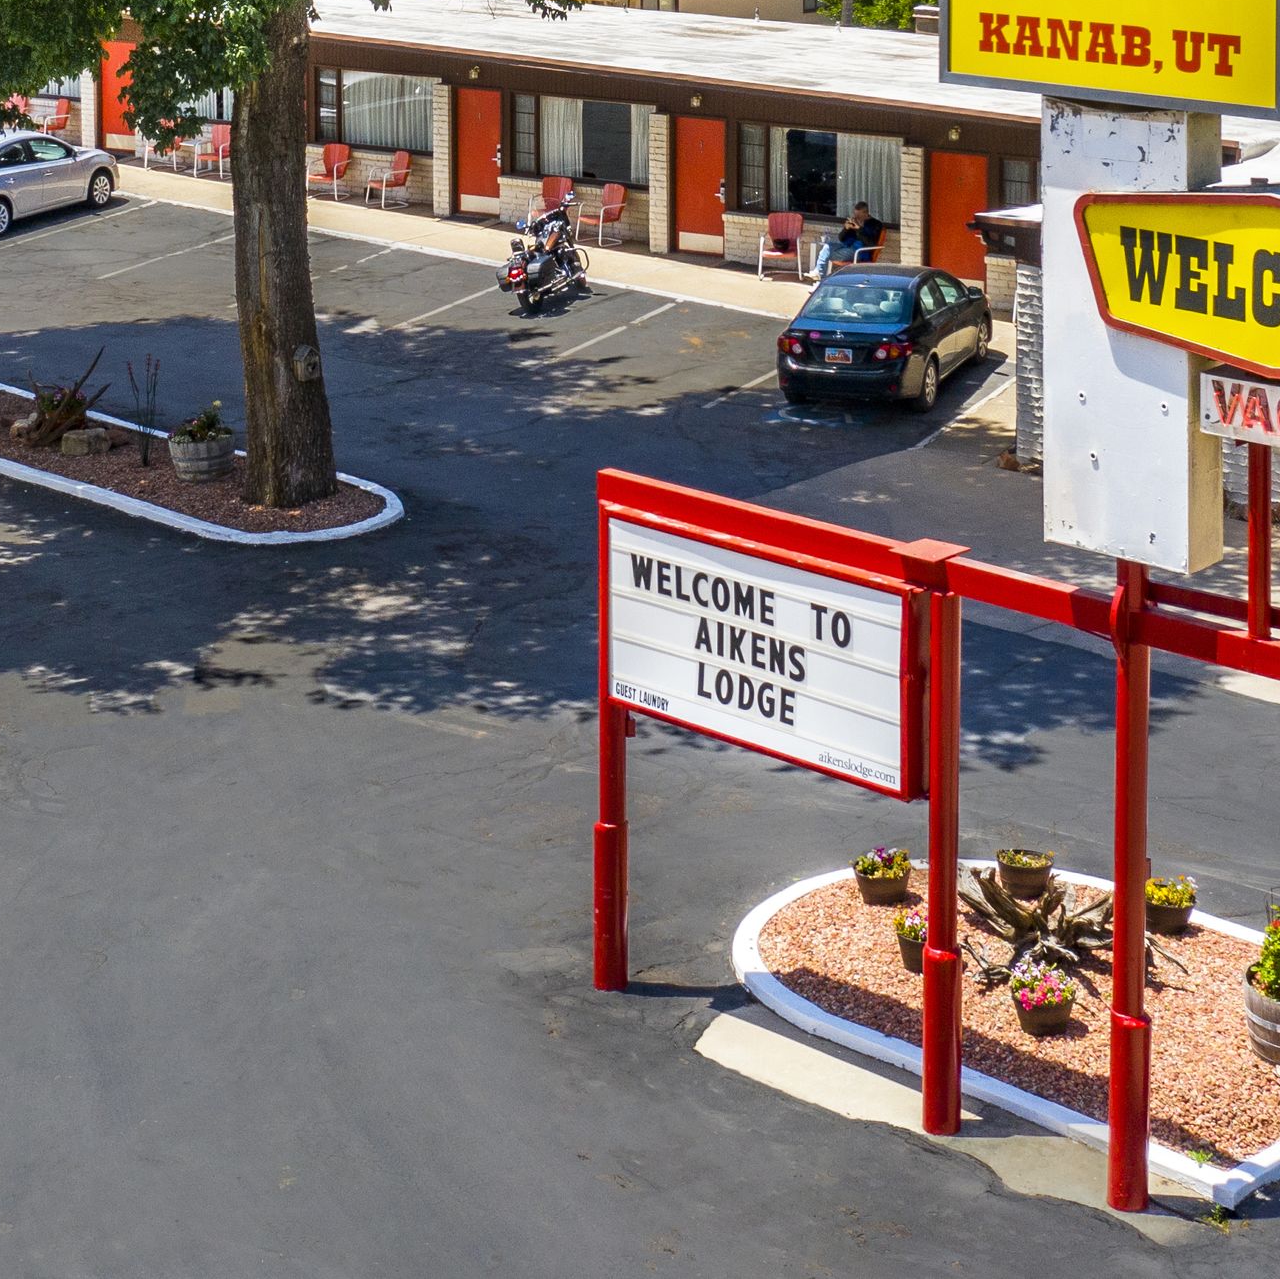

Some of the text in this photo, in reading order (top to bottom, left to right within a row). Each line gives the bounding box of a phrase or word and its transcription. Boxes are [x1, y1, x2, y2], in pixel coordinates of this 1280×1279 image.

[978, 11, 1241, 77] KANAB, UT
[630, 553, 851, 649] WELCOME TO
[694, 617, 805, 683] AIKENS
[615, 682, 670, 712] GUEST LAUNDRY
[697, 661, 795, 727] LODGE
[818, 750, 897, 785] aikenslodge.com
